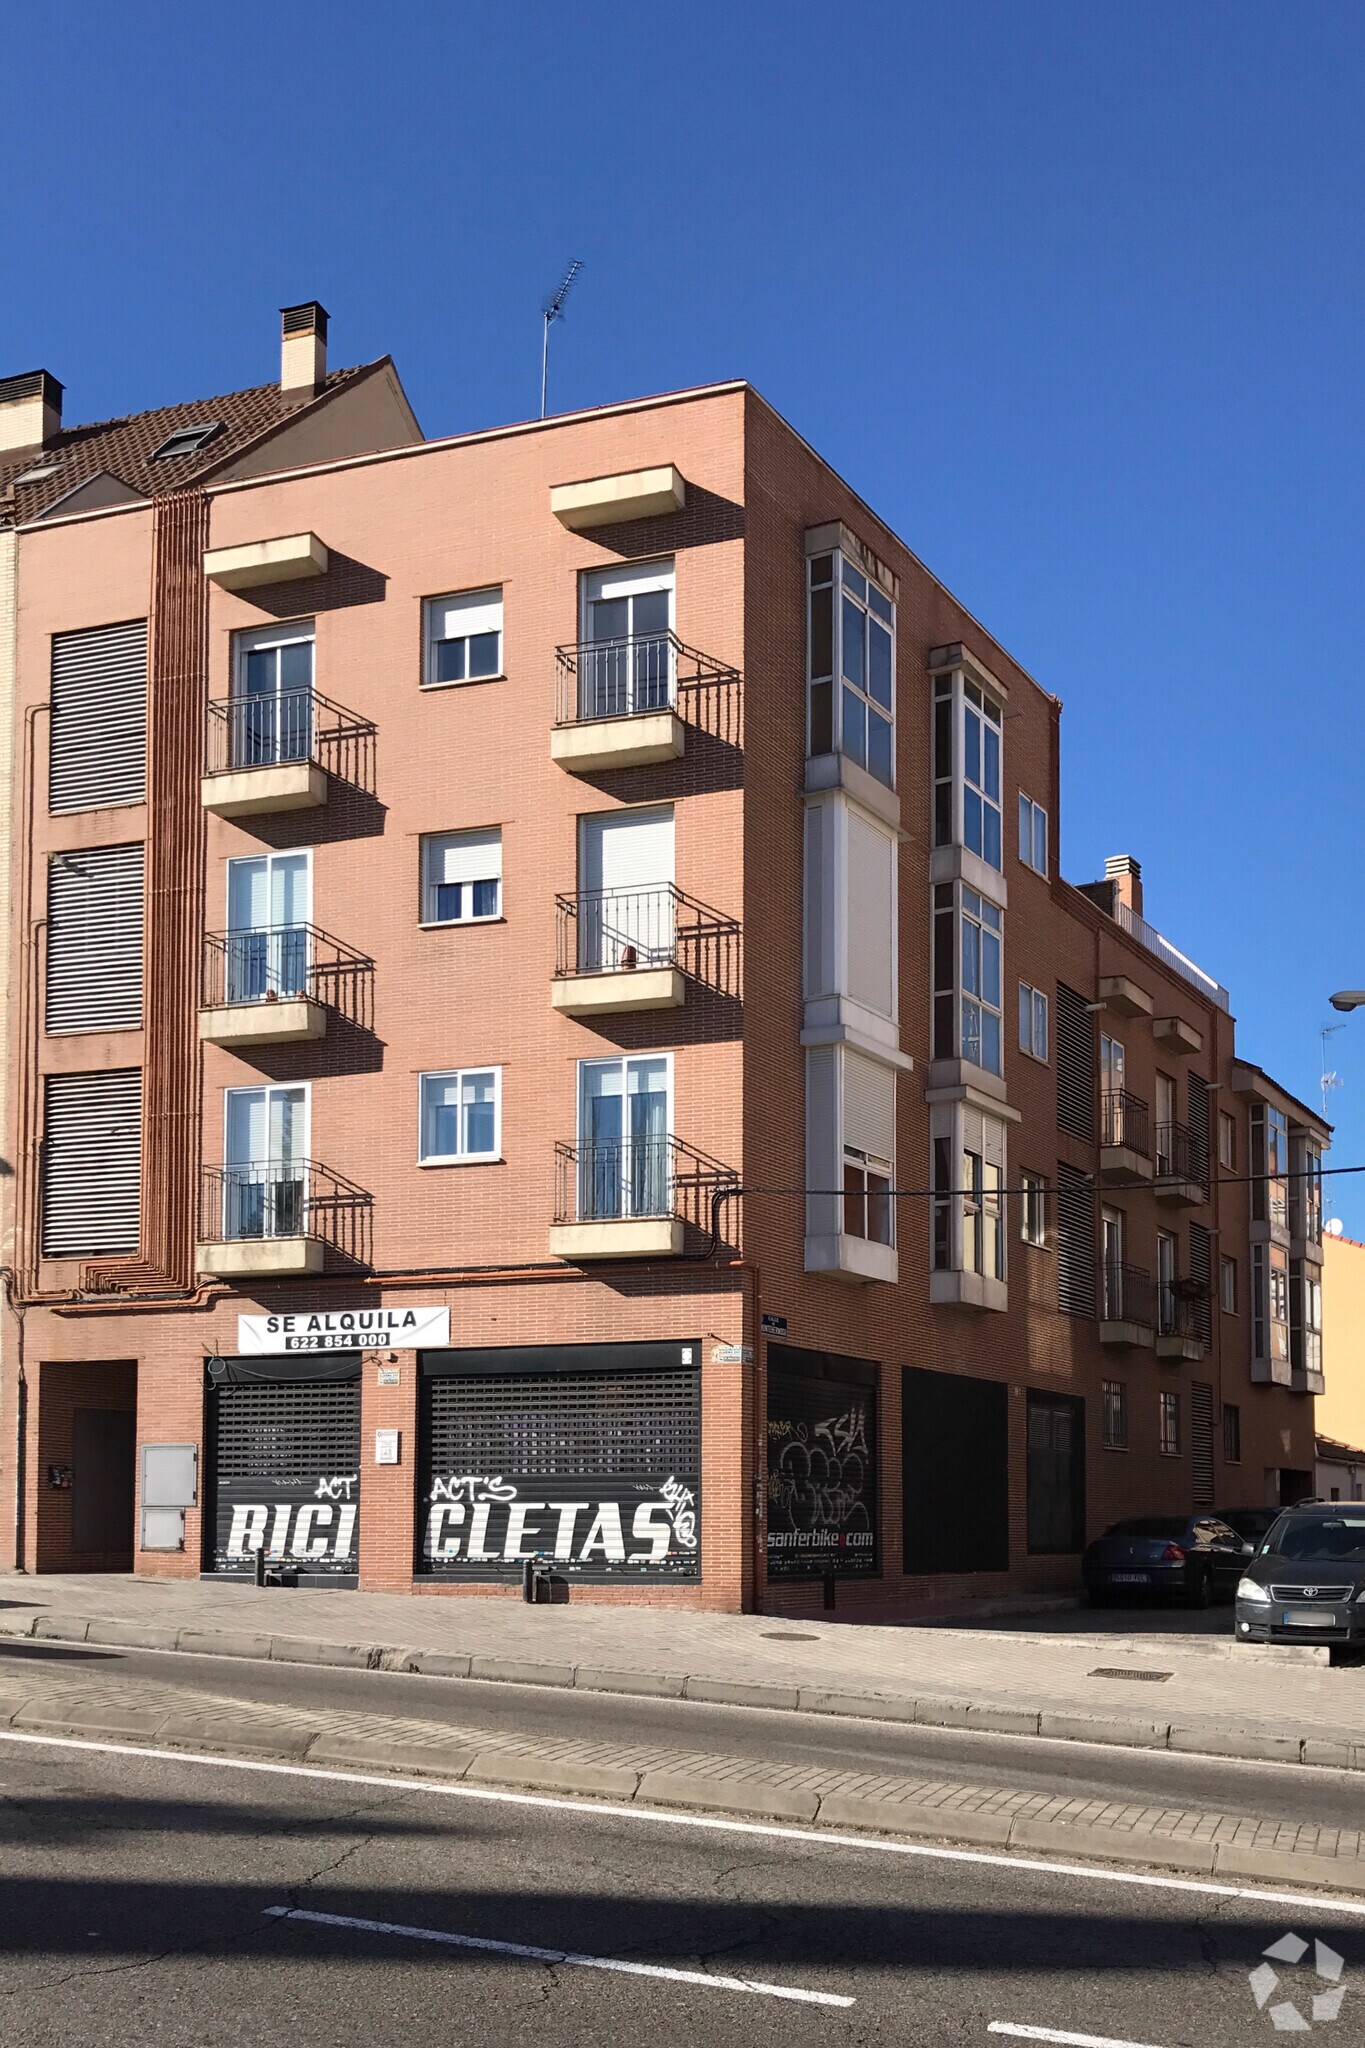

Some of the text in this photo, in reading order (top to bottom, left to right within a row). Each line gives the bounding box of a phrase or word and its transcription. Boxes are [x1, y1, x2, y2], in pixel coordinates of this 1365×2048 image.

[266, 1311, 417, 1333] SE ALQUILA
[290, 1334, 387, 1349] 622 854 000
[226, 1504, 358, 1559] BICI
[423, 1502, 676, 1560] CLETAS
